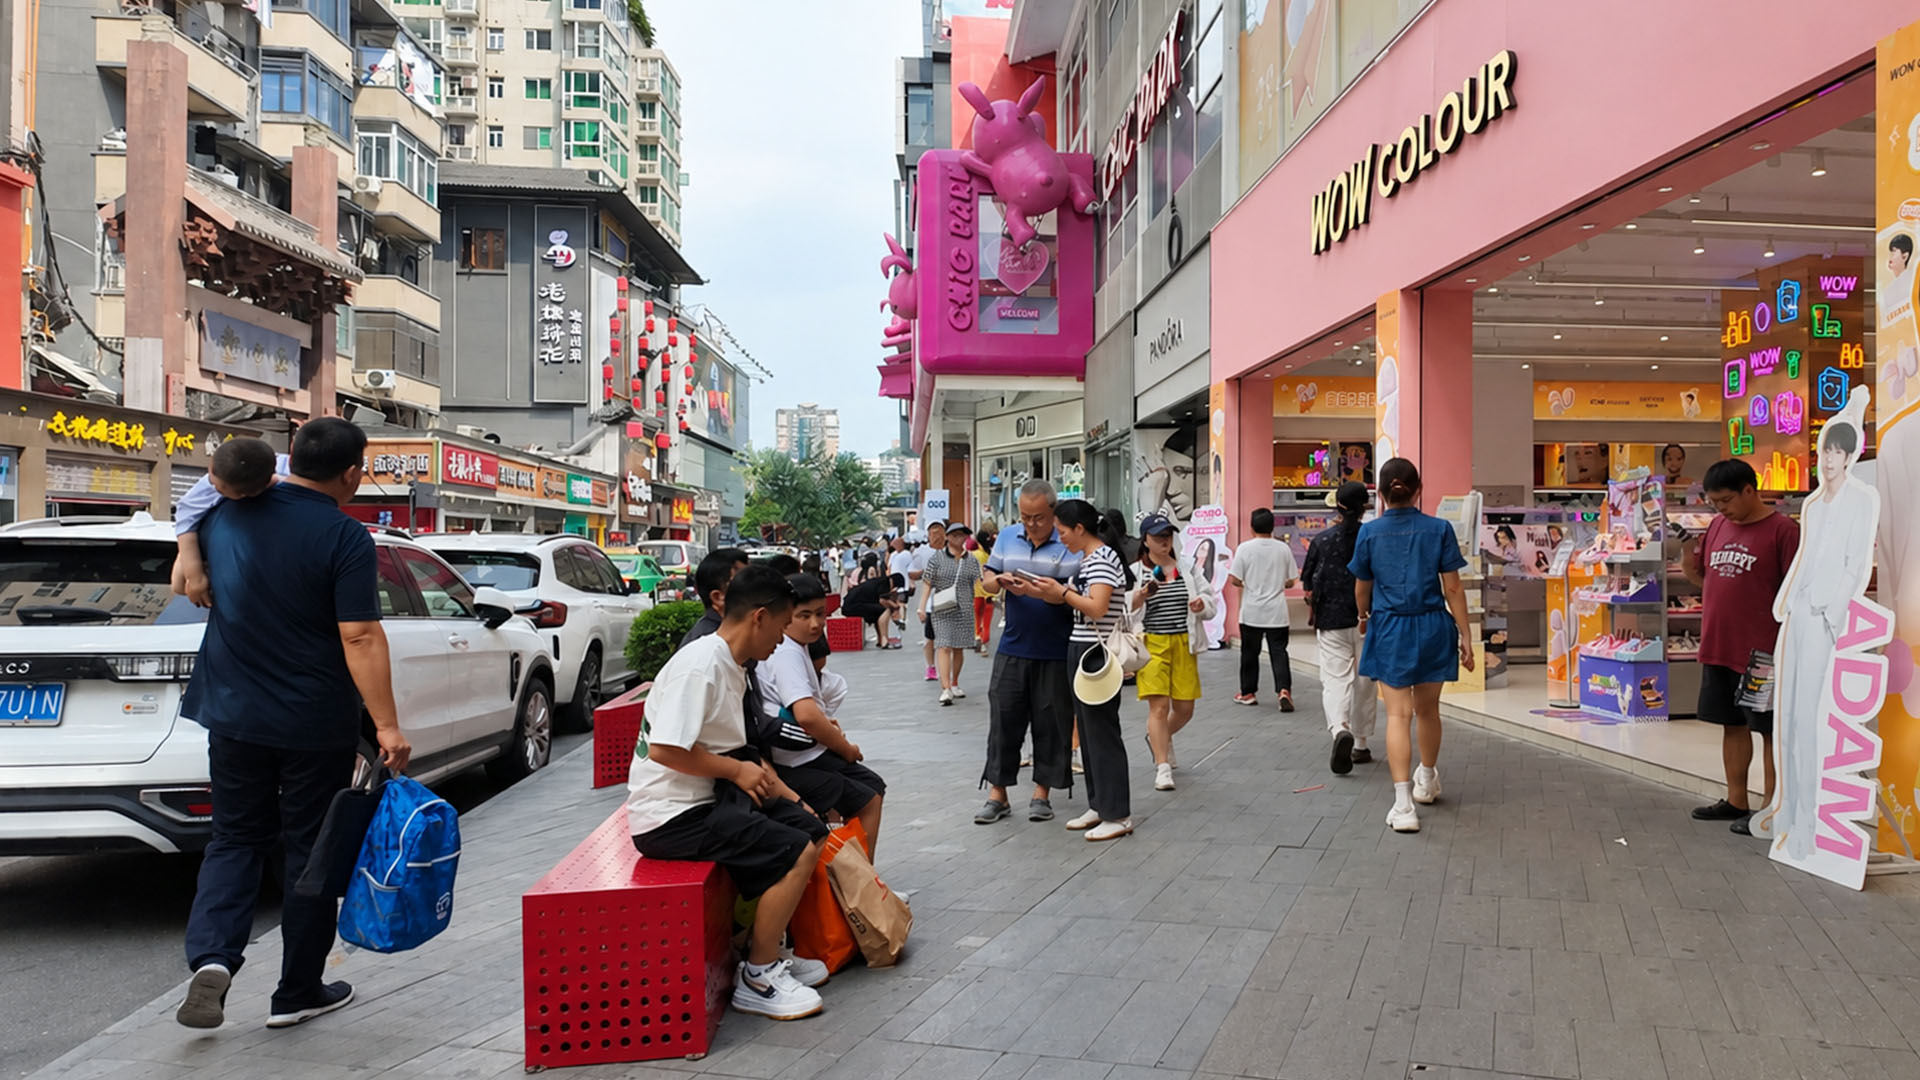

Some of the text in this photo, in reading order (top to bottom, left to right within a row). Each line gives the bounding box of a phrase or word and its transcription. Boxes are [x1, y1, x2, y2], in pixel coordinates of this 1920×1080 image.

[1311, 49, 1518, 255] WOW COLOUR
[1820, 275, 1857, 291] WOW
[1000, 308, 1039, 318] WELCOME
[1749, 346, 1782, 369] WOW
[1815, 598, 1889, 862] ADAM
